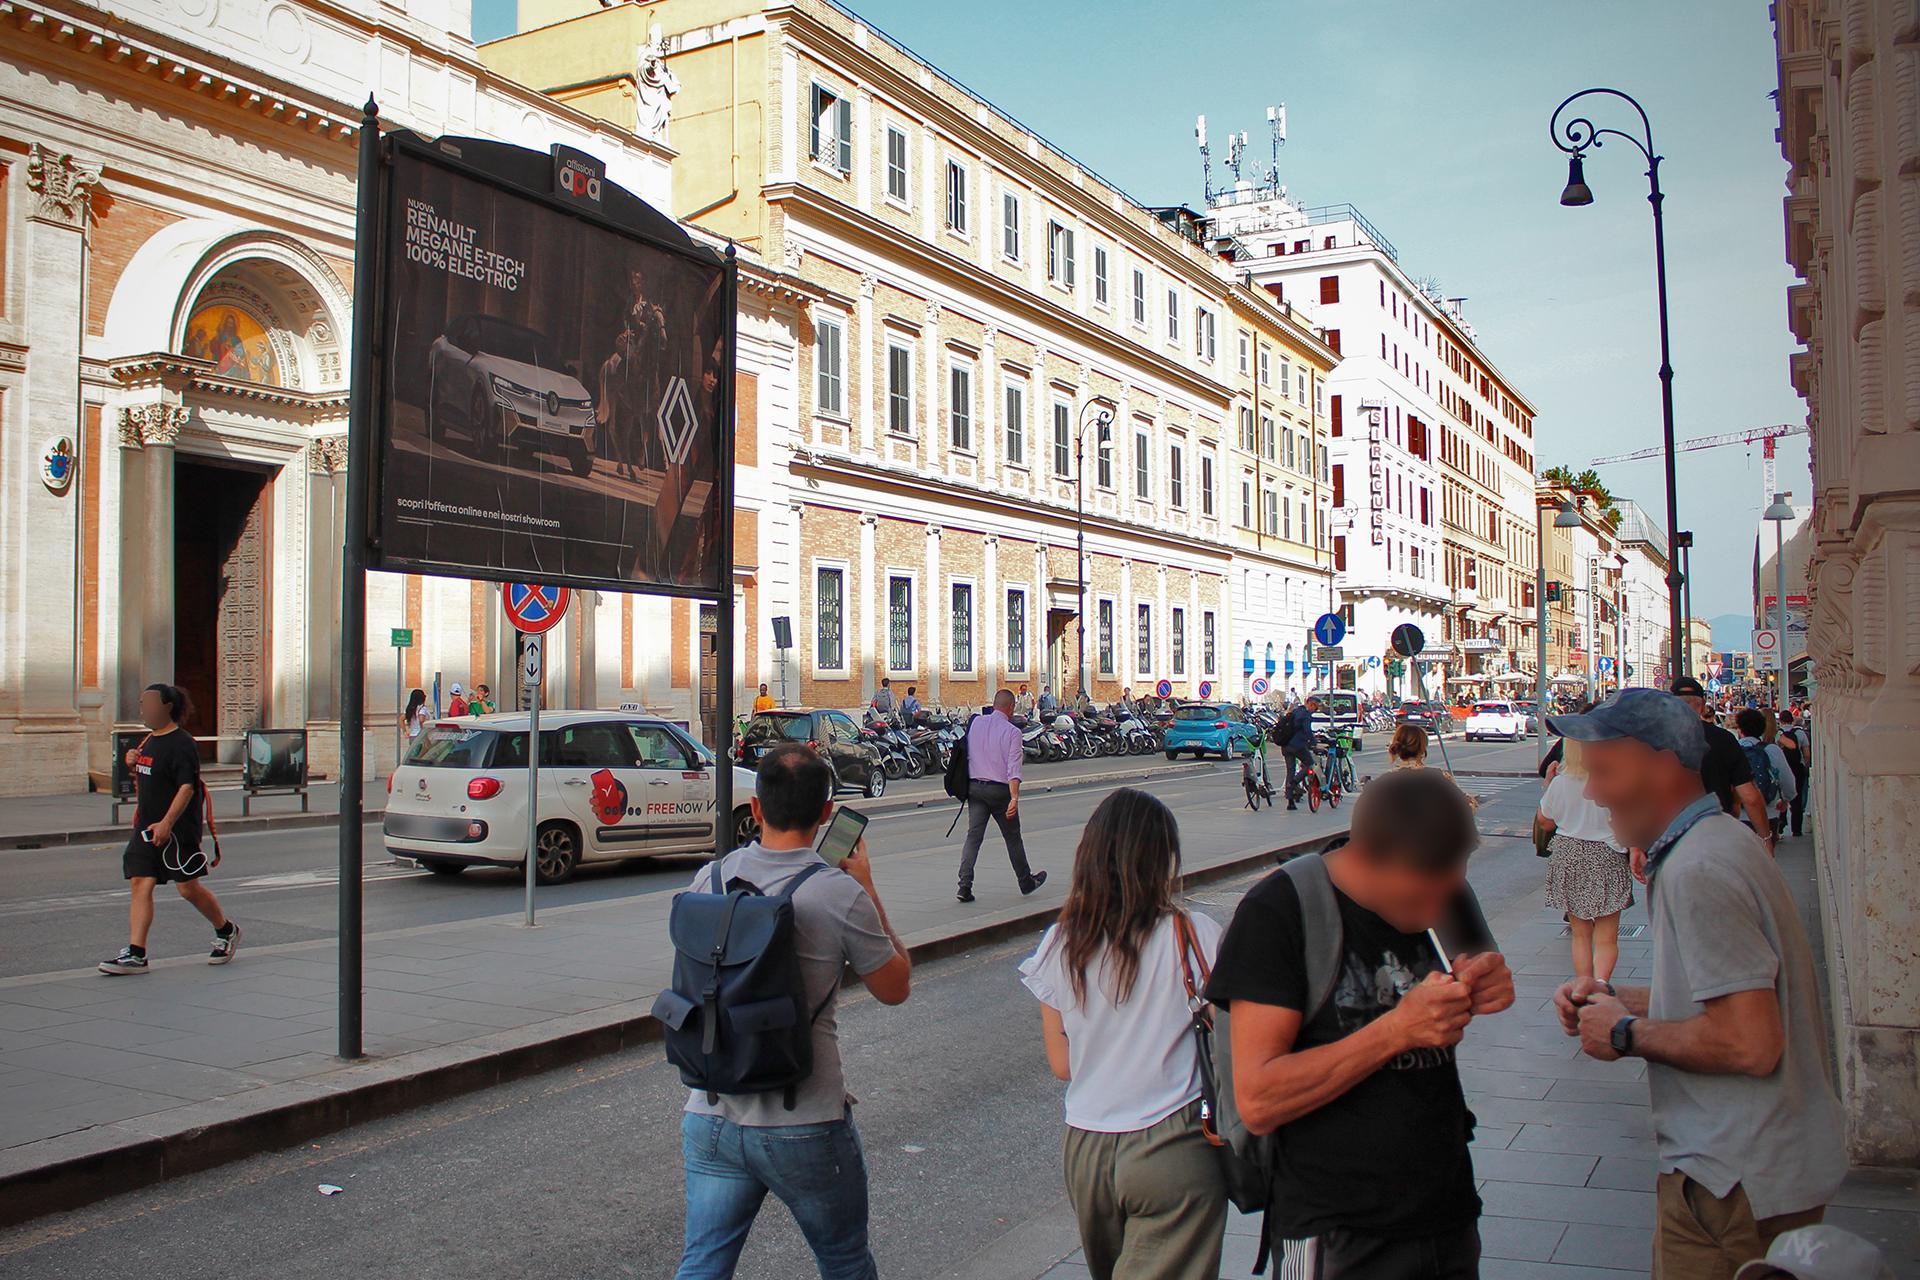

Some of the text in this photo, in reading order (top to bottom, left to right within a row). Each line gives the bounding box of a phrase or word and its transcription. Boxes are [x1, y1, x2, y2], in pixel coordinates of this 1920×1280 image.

[560, 166, 601, 202] apa
[566, 158, 596, 178] affissioni
[407, 198, 435, 215] NUOVA
[407, 207, 477, 244] RENAULT
[405, 242, 518, 292] 100% ELECTRIC
[406, 225, 525, 278] MEGANE E-TECH
[1372, 412, 1385, 541] SIRACUSA
[397, 498, 561, 529] scopri l'offerta online e nei nostri showroom
[647, 802, 703, 815] FREENOW
[1779, 1231, 1828, 1265] NY
